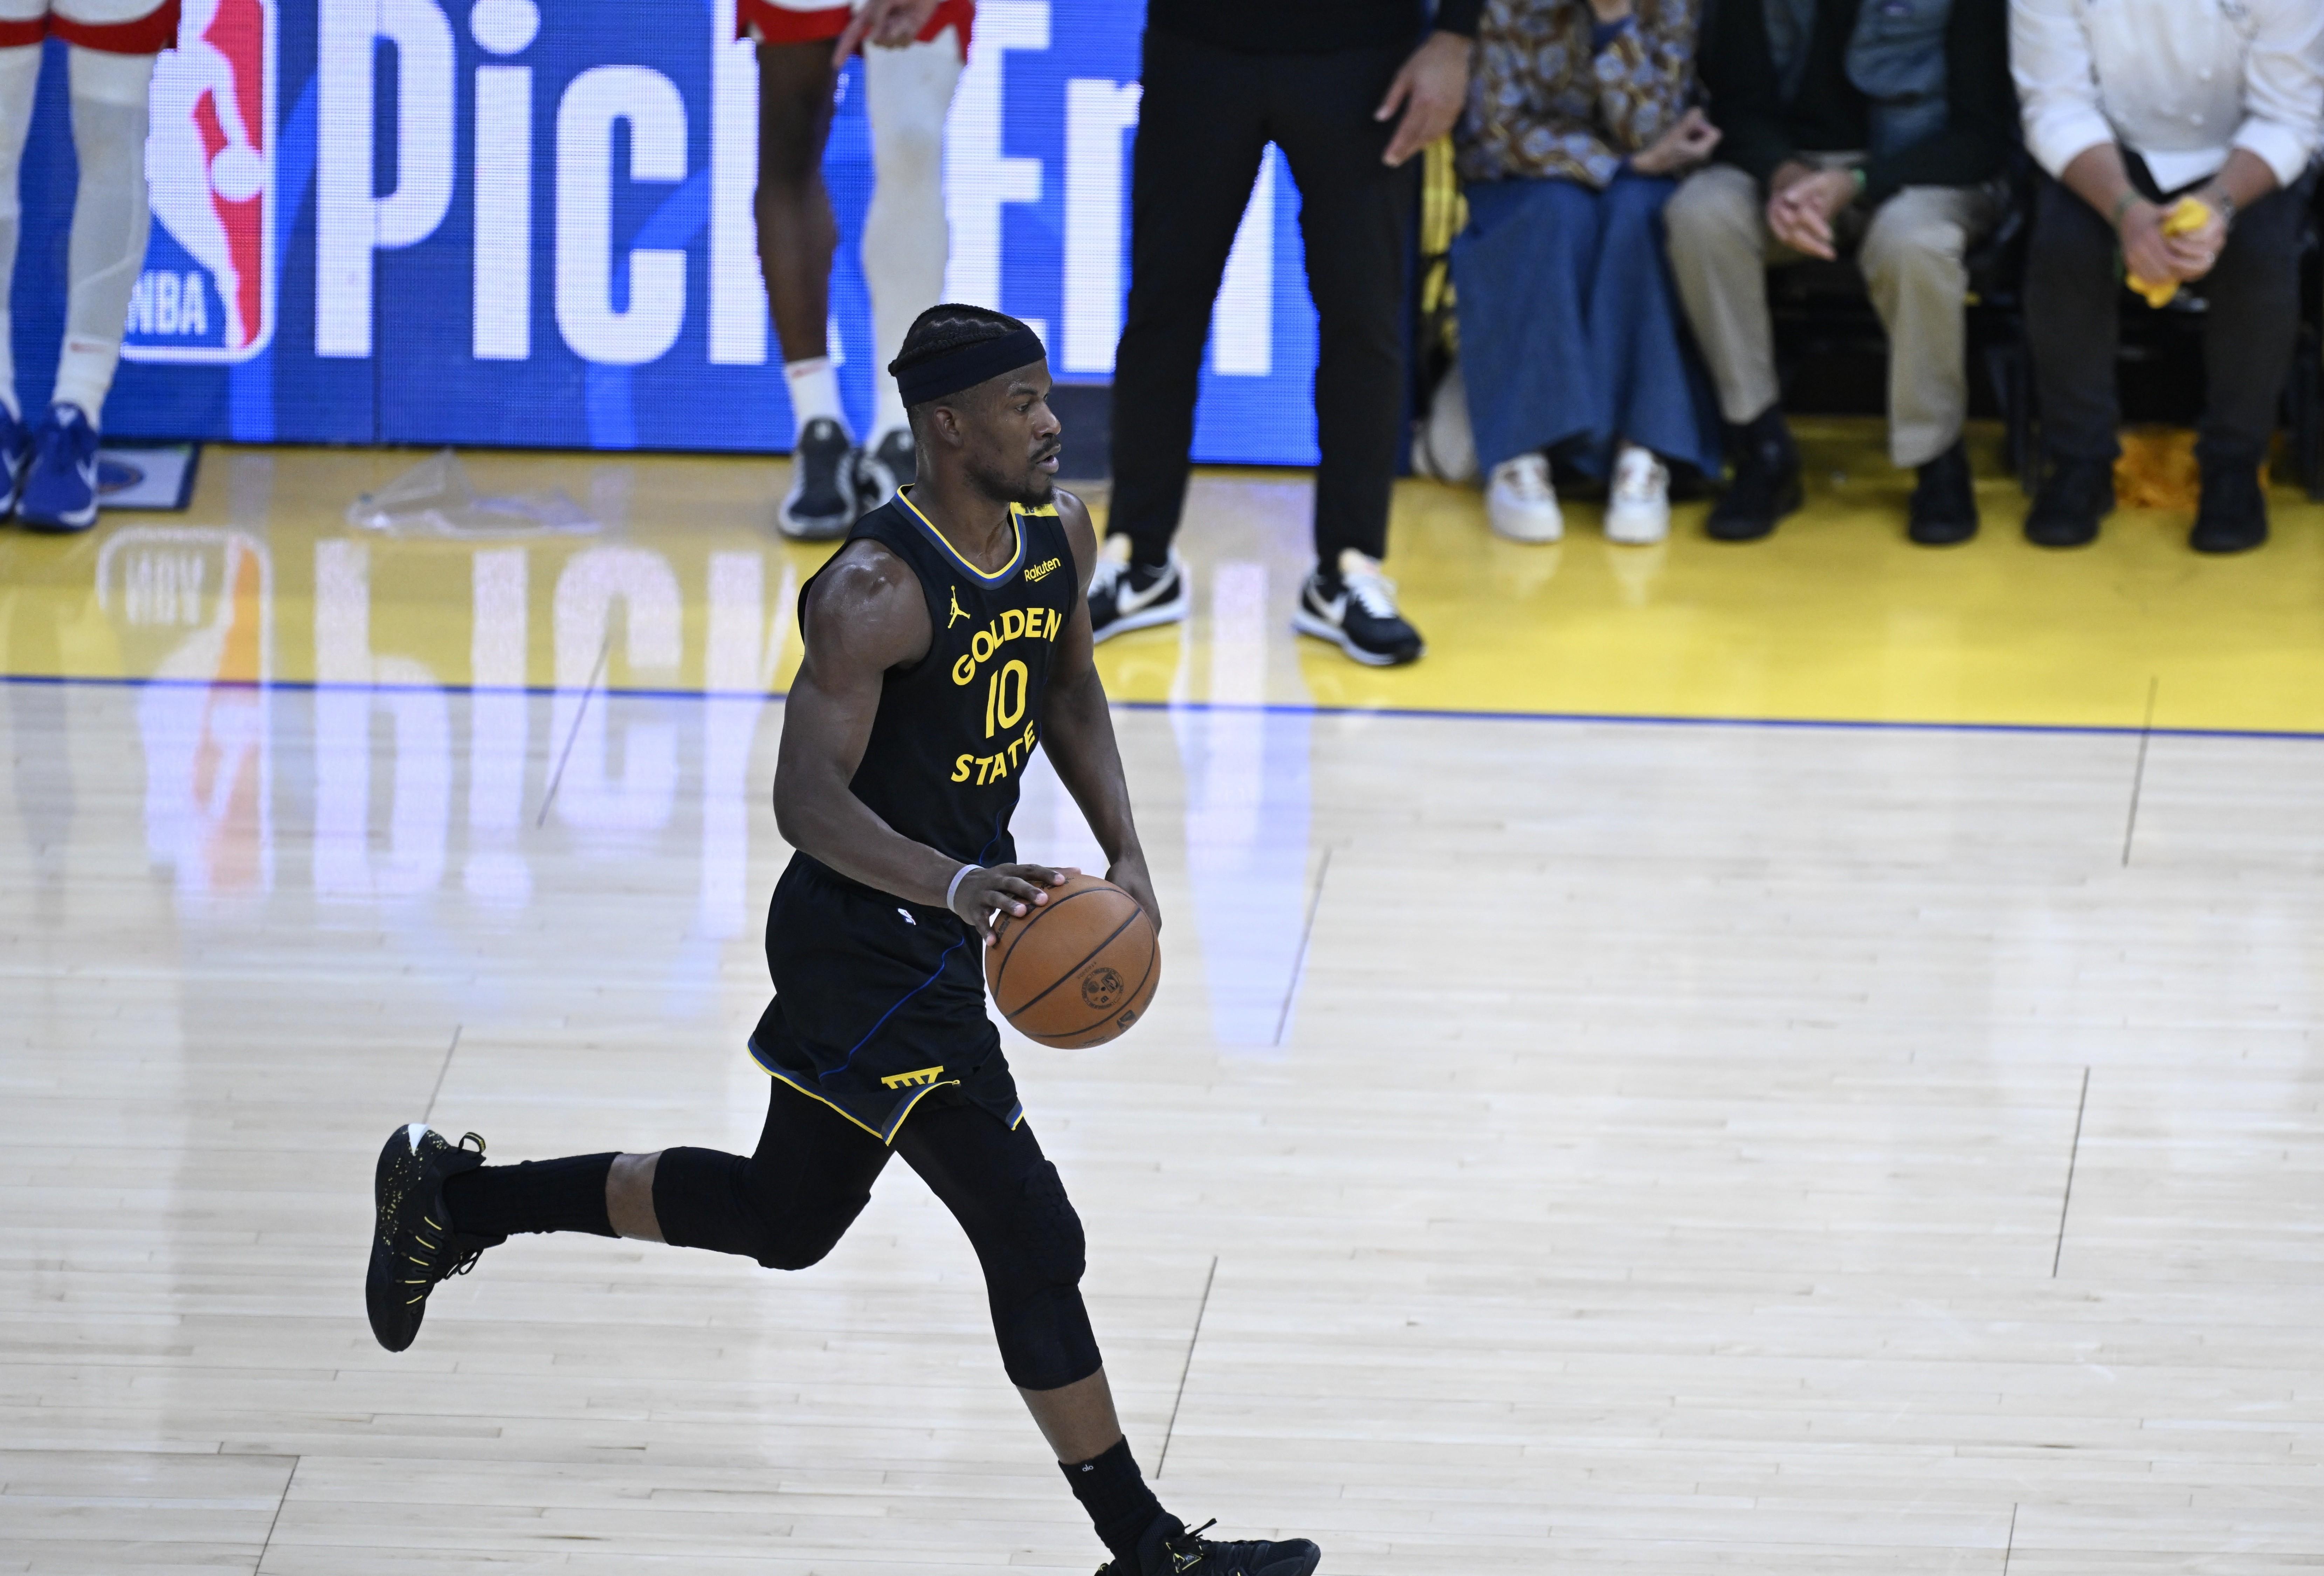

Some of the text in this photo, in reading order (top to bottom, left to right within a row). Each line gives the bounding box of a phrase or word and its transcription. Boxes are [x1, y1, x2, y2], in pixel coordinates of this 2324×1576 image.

[125, 270, 209, 336] NBA
[1024, 557, 1061, 582] Rakuten
[952, 608, 1062, 685] GOLDEN
[986, 659, 1028, 738] 10
[951, 719, 1035, 785] STATE
